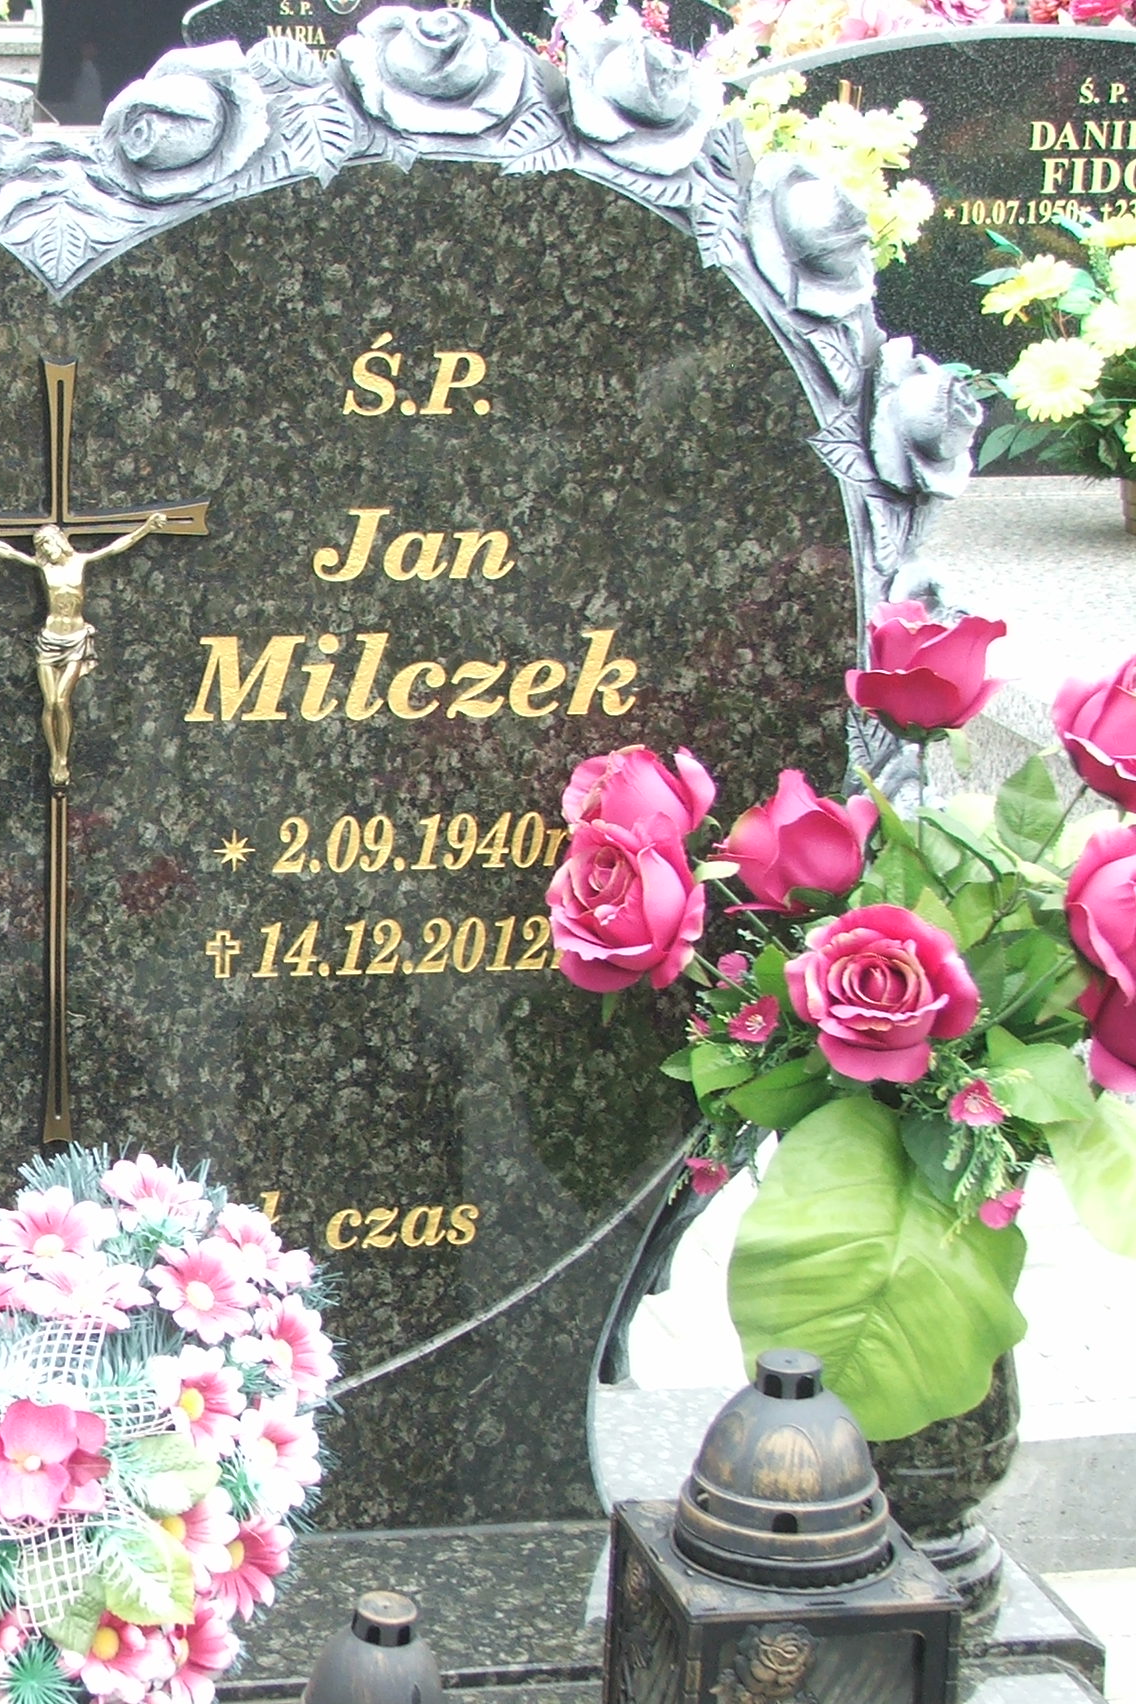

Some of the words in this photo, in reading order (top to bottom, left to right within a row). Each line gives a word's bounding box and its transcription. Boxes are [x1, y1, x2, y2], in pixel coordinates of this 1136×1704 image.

[266, 25, 326, 45] MARIA
[1079, 77, 1100, 104] Ś.
[1109, 83, 1128, 104] P.
[312, 508, 516, 583] Jan
[183, 628, 639, 722] Milczek
[252, 915, 563, 978] 14.12.2012
[325, 1203, 480, 1251] czas
